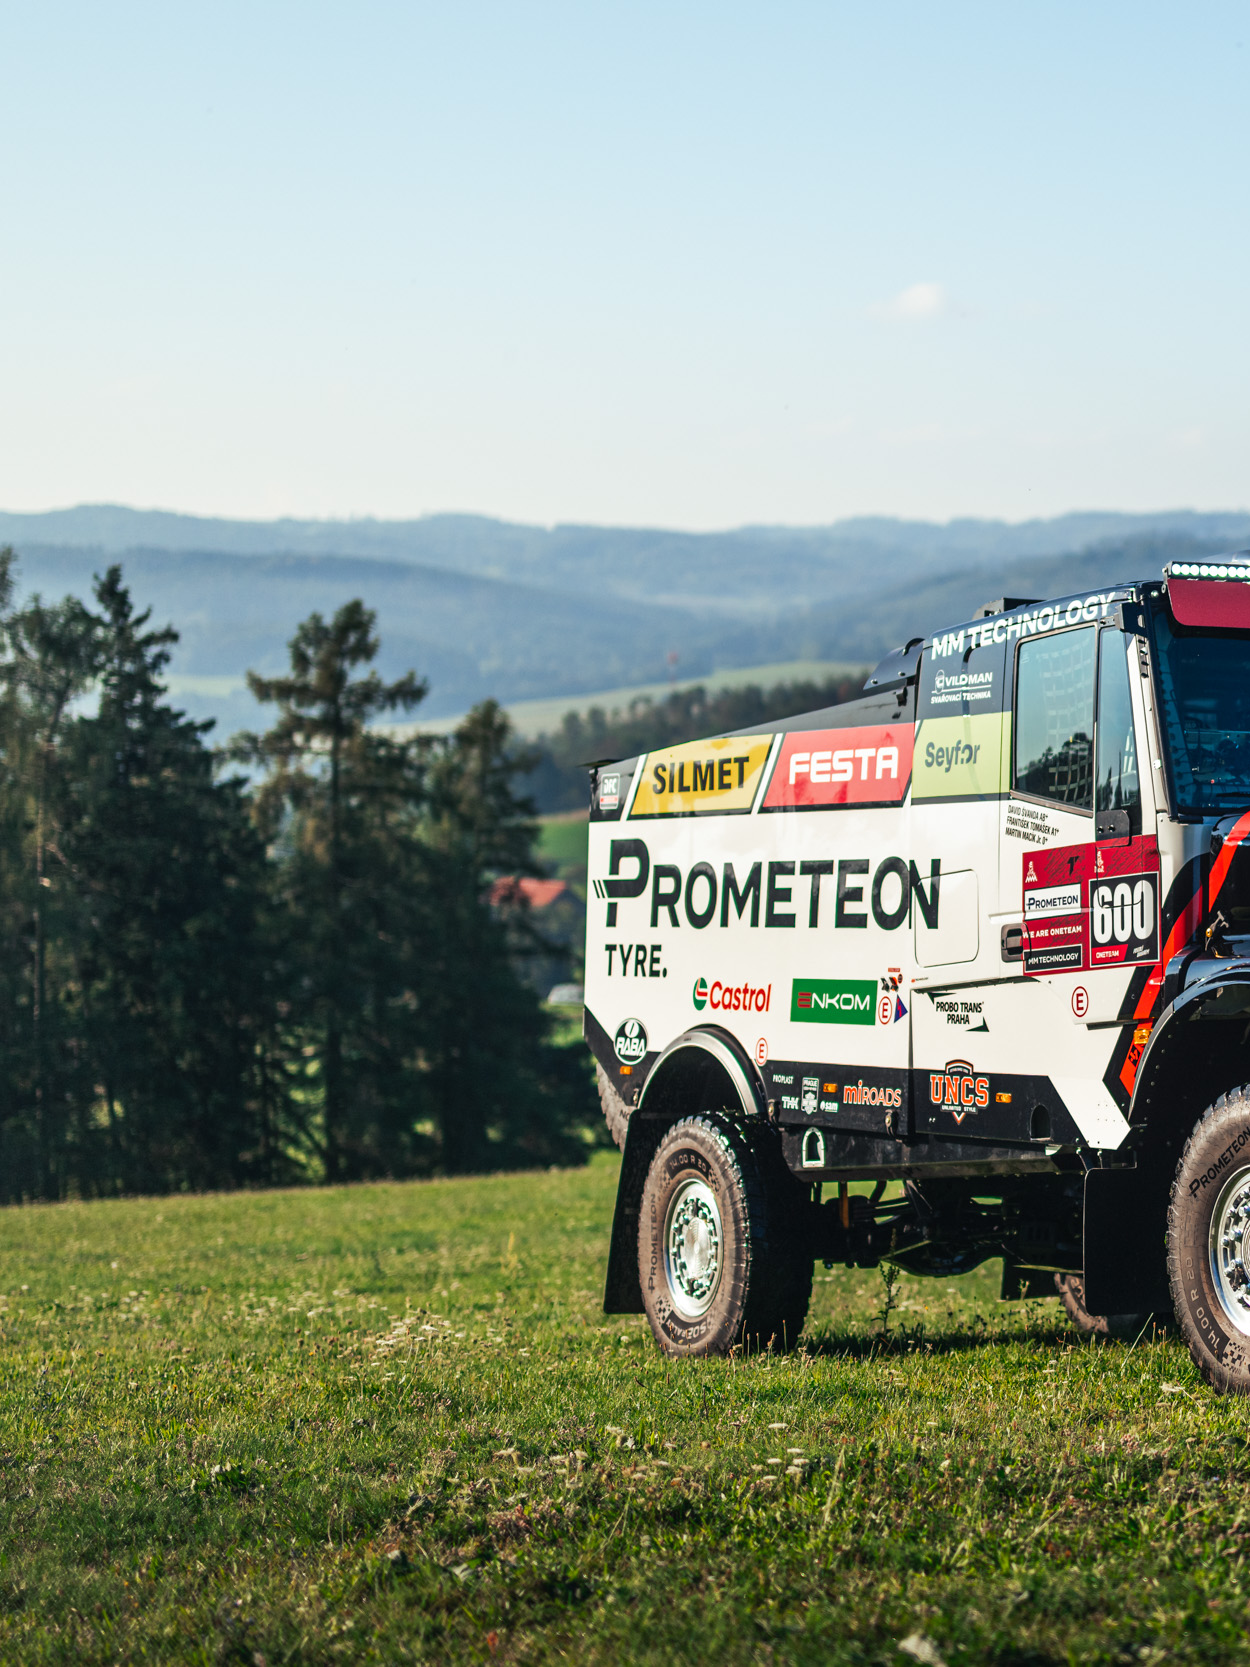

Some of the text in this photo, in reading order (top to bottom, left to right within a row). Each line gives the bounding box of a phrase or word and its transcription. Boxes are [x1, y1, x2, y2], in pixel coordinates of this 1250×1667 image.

[931, 592, 1115, 660] MM TECHNOLOGY
[962, 690, 991, 701] TECHNIKA
[789, 746, 899, 785] FESTA
[924, 739, 980, 773] Seyfor
[652, 757, 750, 794] SILMET
[1005, 827, 1022, 839] MARTIN
[593, 838, 941, 930] PROMETEON
[1026, 895, 1079, 910] PROMETEON
[1093, 880, 1154, 944] 600
[1036, 928, 1049, 938] ARE
[1050, 925, 1082, 936] ONETEAM
[605, 944, 667, 978] TYRE.
[1028, 952, 1079, 965] MM TECHNOLOGY
[710, 981, 772, 1012] Castrol
[797, 991, 870, 1011] ENKOM
[936, 1001, 959, 1012] PROBO
[947, 1013, 970, 1024] PRAHA
[772, 1074, 794, 1084] PROPLAST
[930, 1074, 989, 1107] UNCS
[647, 1193, 657, 1294] PROMETEON
